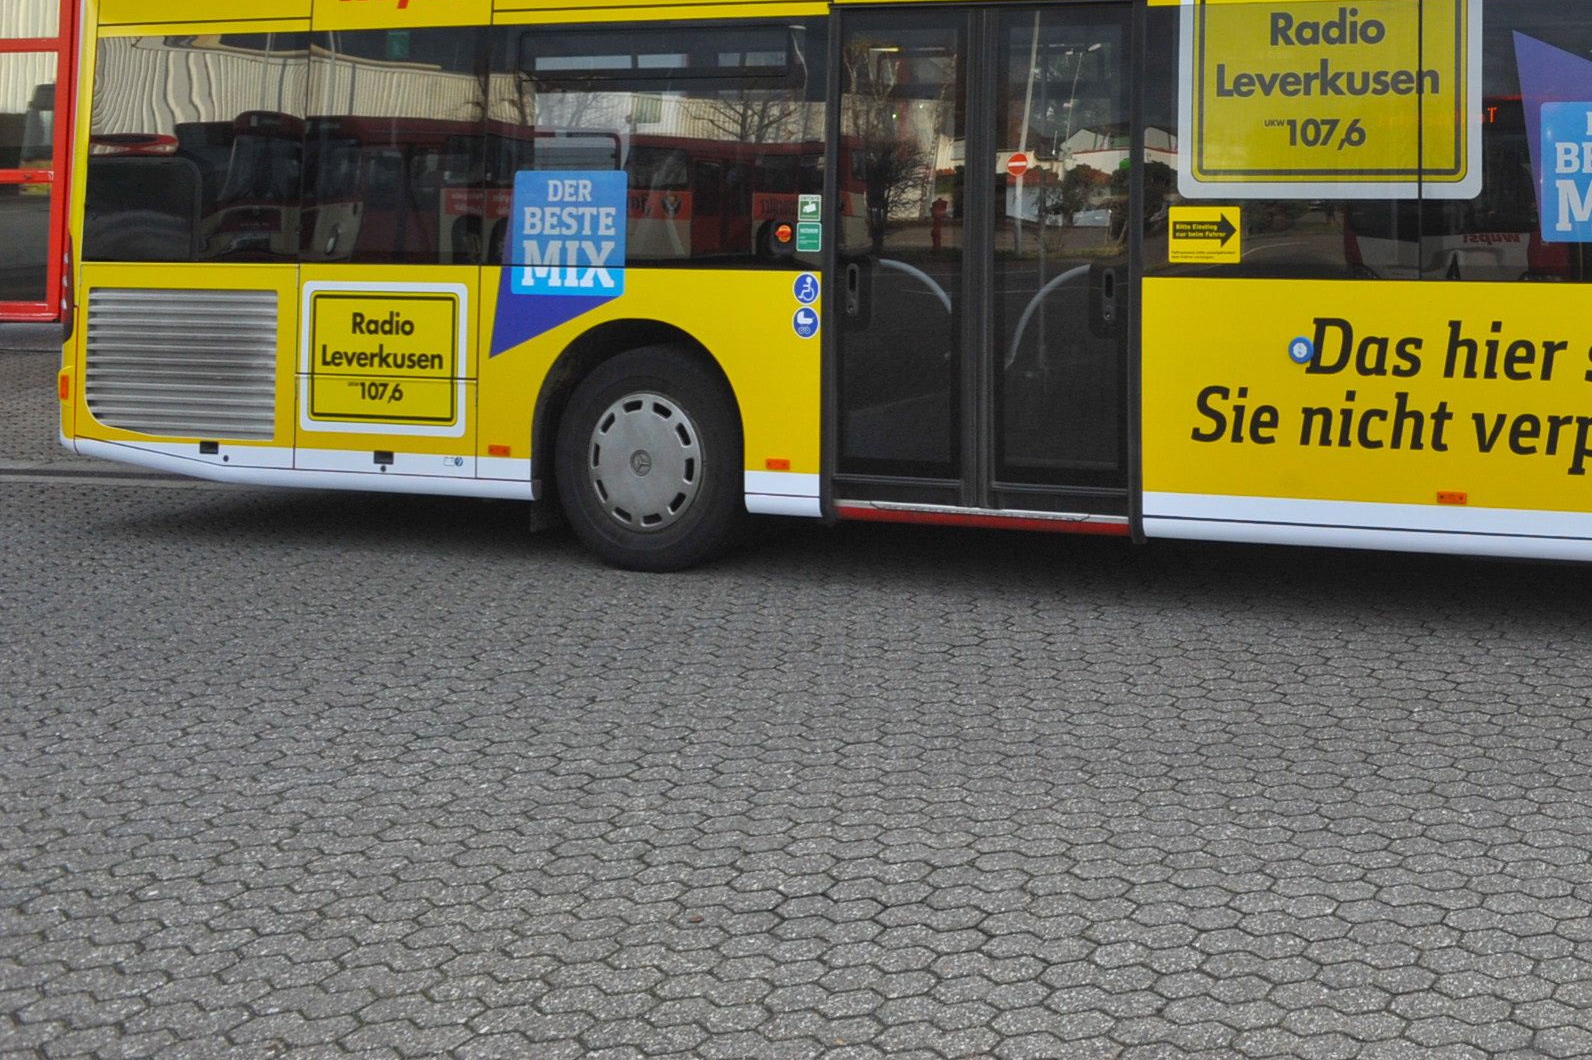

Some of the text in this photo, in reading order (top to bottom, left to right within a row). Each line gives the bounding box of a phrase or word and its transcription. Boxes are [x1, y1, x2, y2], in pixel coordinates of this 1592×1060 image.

[1269, 6, 1386, 47] Radio
[1215, 59, 1441, 98] Leverkusen
[1264, 117, 1367, 151] UKW 107,6
[548, 179, 592, 203] DER
[523, 206, 616, 237] BESTE
[522, 240, 615, 288] MIX
[351, 310, 415, 336] Radio
[321, 343, 444, 370] Leverkusen
[1304, 317, 1423, 378] Das
[1443, 320, 1569, 381] hier
[358, 381, 404, 404] 107,6
[1191, 385, 1279, 445] Sie
[1299, 390, 1454, 452] nicht
